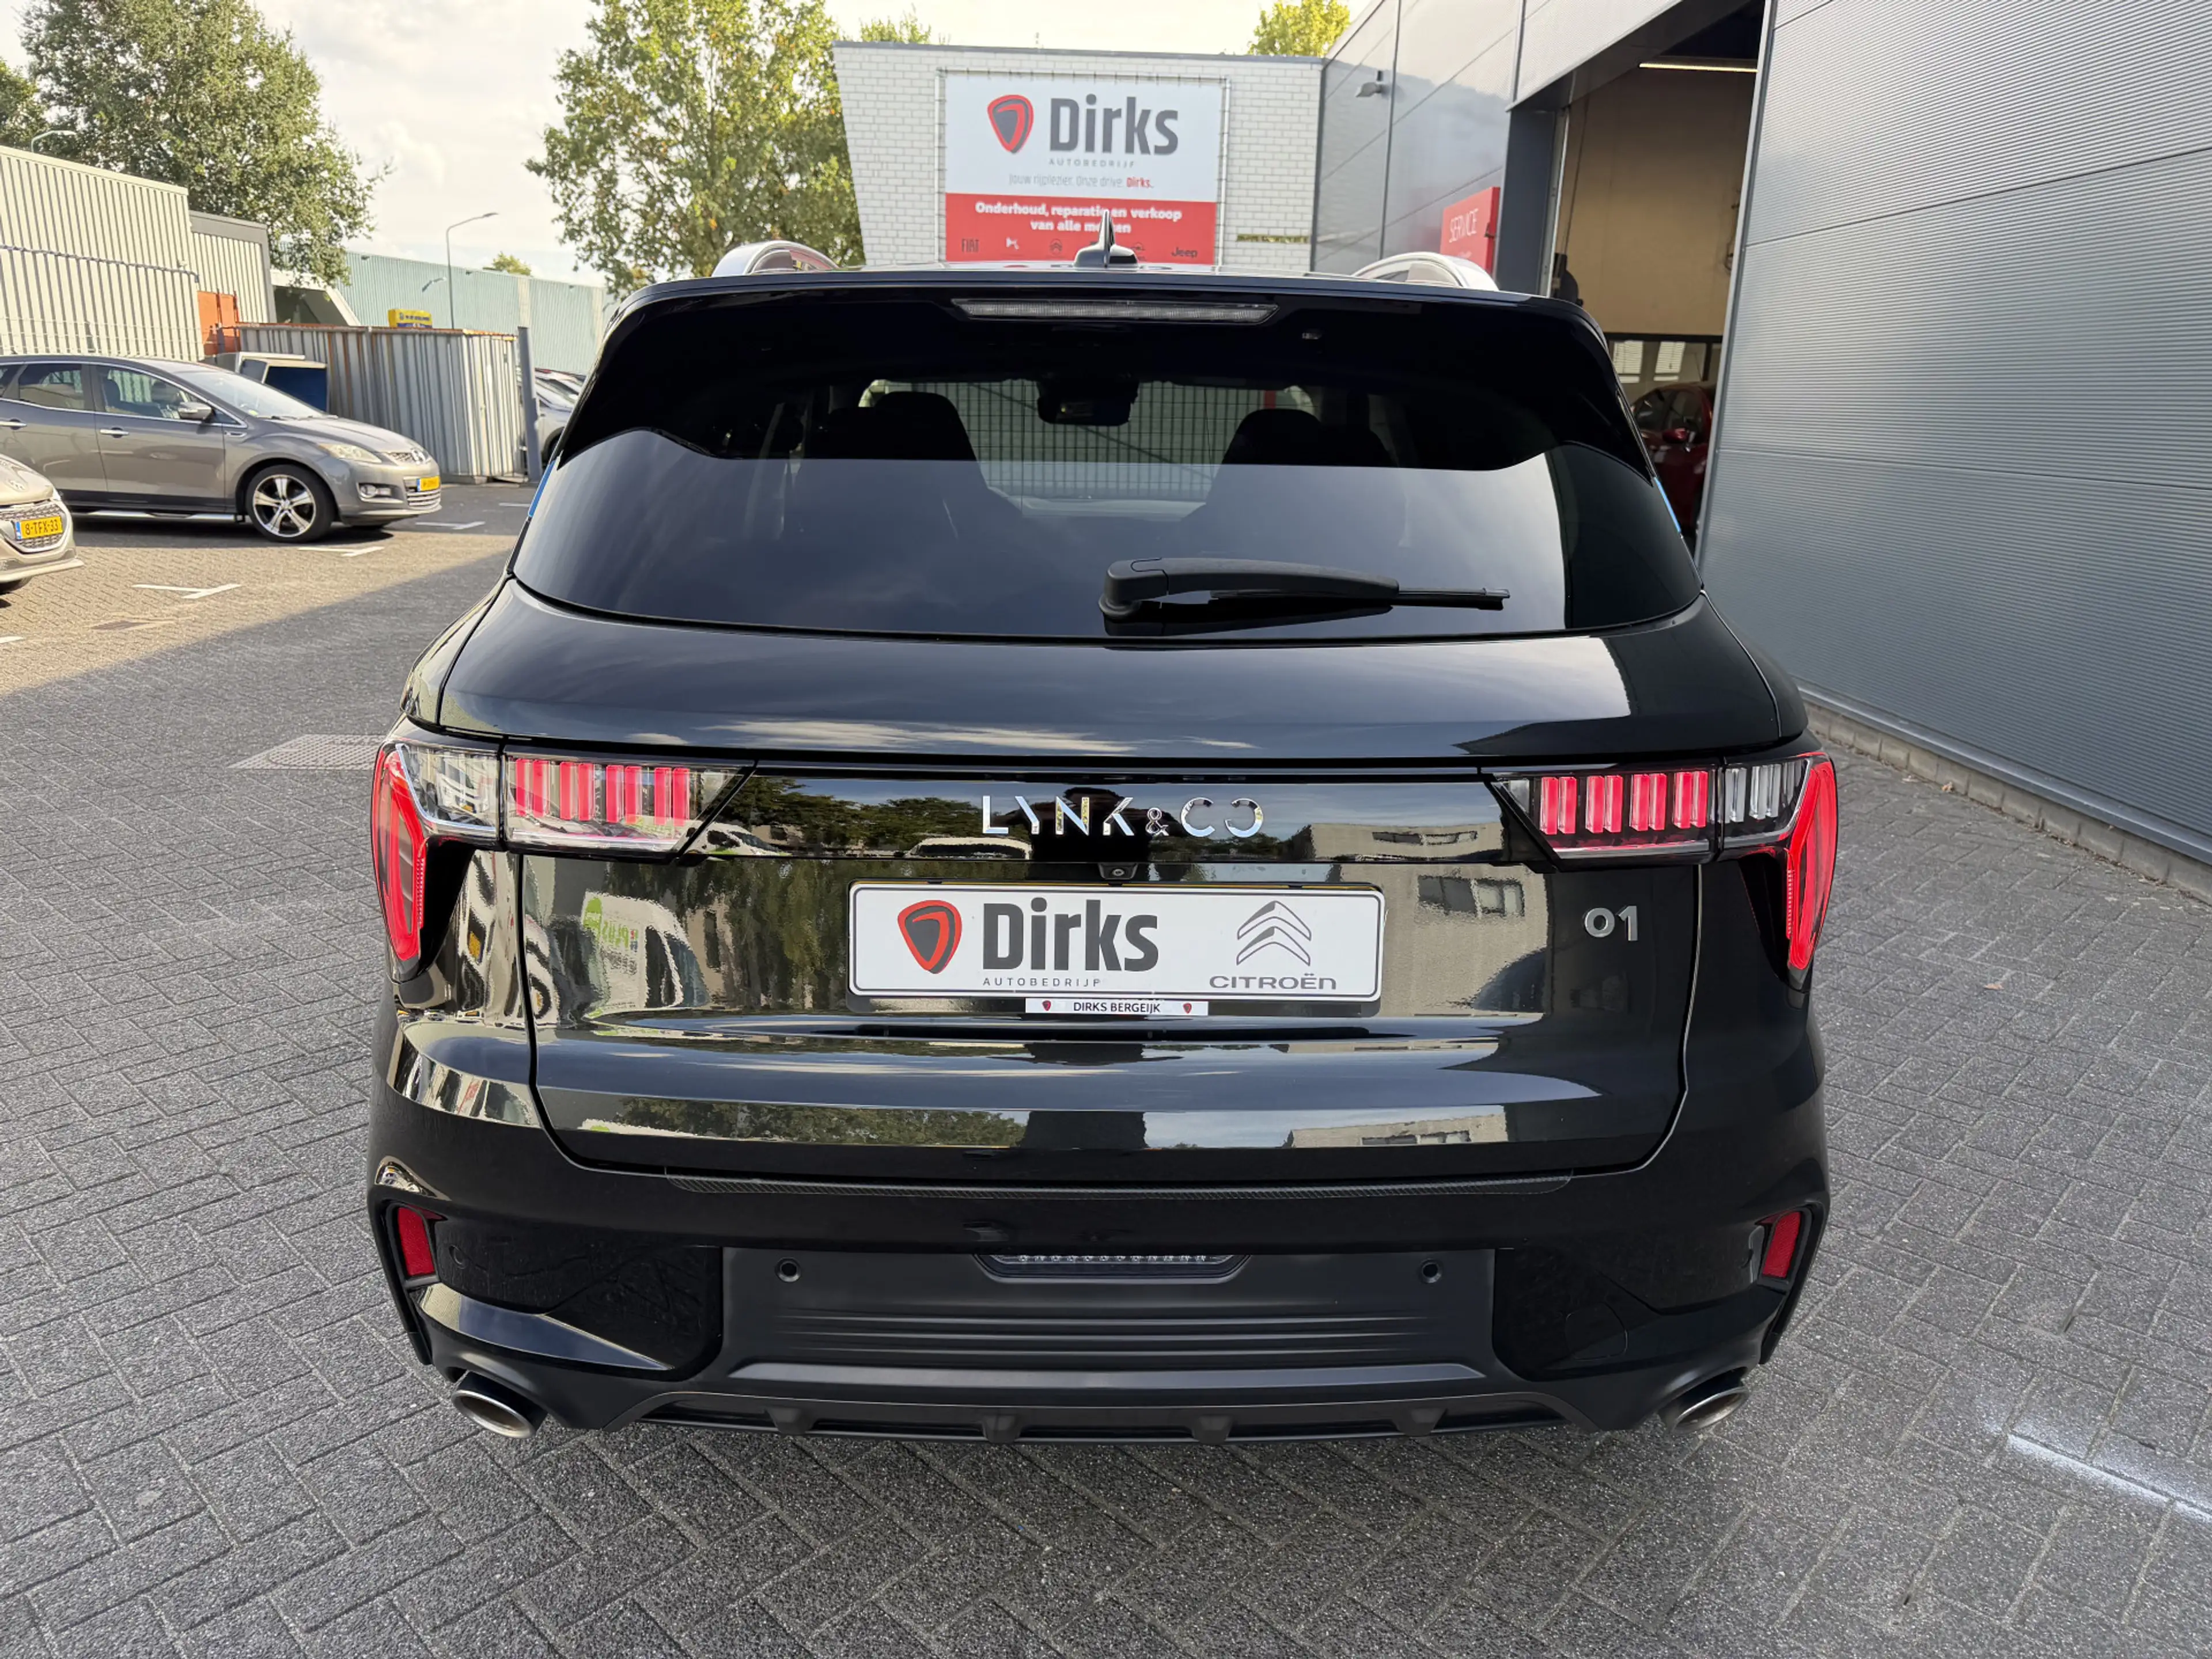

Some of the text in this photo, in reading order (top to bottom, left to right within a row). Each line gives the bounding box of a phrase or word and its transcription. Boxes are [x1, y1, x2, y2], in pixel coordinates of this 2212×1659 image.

[1050, 93, 1179, 156] Dirks
[1048, 158, 1135, 169] AUTOBEDRIJF
[975, 202, 1049, 217] Onderhoud,
[1131, 207, 1182, 222] verkoop
[1030, 221, 1054, 230] van
[1056, 220, 1081, 232] alle
[961, 238, 979, 252] FIAT
[1171, 247, 1198, 258] Jeep
[1584, 905, 1638, 941] 01
[983, 896, 1159, 972] Dirks
[1073, 1001, 1161, 1014] DIRKS BERGEIJK
